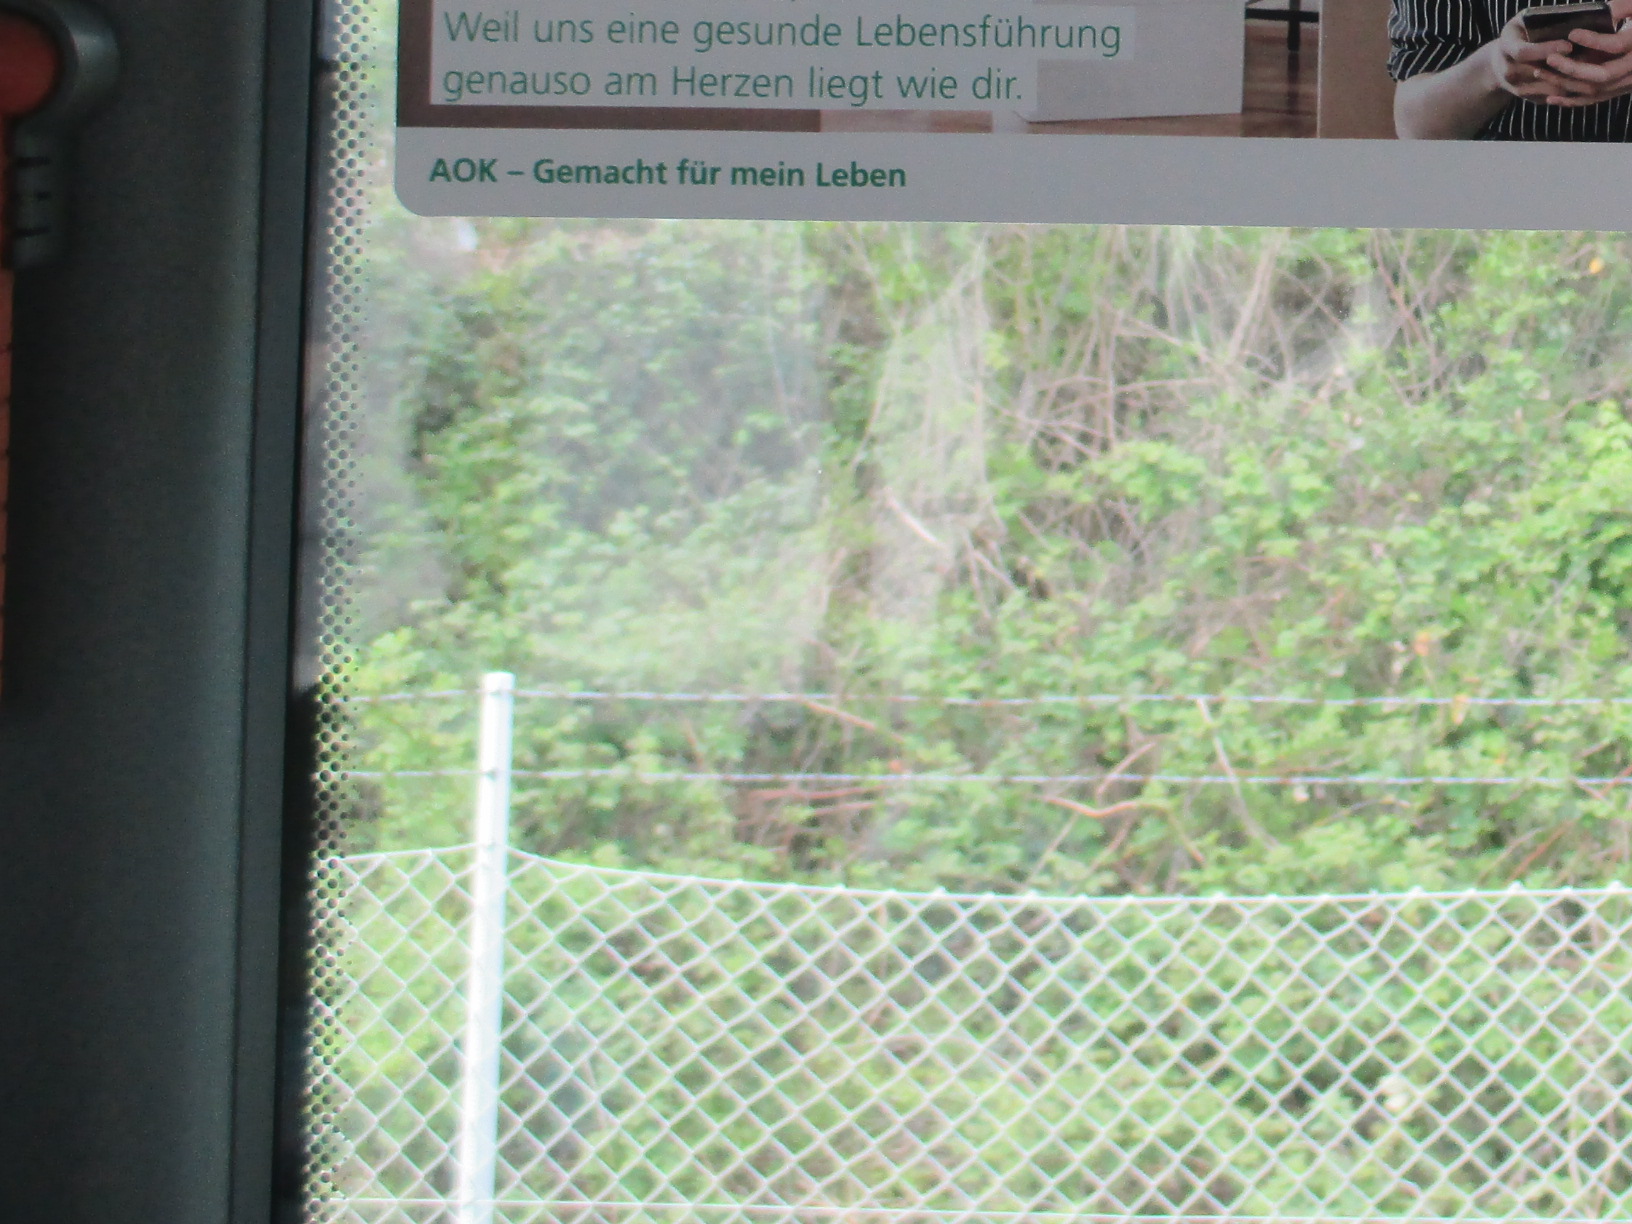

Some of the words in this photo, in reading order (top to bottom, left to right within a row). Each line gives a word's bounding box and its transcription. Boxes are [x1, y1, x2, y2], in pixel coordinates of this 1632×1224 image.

[445, 10, 518, 43] Weil
[534, 19, 593, 44] uns
[608, 14, 679, 45] eine
[694, 14, 844, 52] gesunde
[856, 15, 1122, 56] Lebensführung
[444, 71, 592, 102] genauso
[606, 72, 657, 96] am
[673, 67, 794, 99] Herzen
[809, 68, 885, 107] liegt
[896, 69, 958, 100] wie
[972, 70, 1022, 100] dir.
[429, 158, 498, 183] AOK
[532, 159, 668, 185] Gemacht
[676, 158, 722, 186] für
[730, 160, 805, 188] mein
[815, 162, 907, 189] Leben
